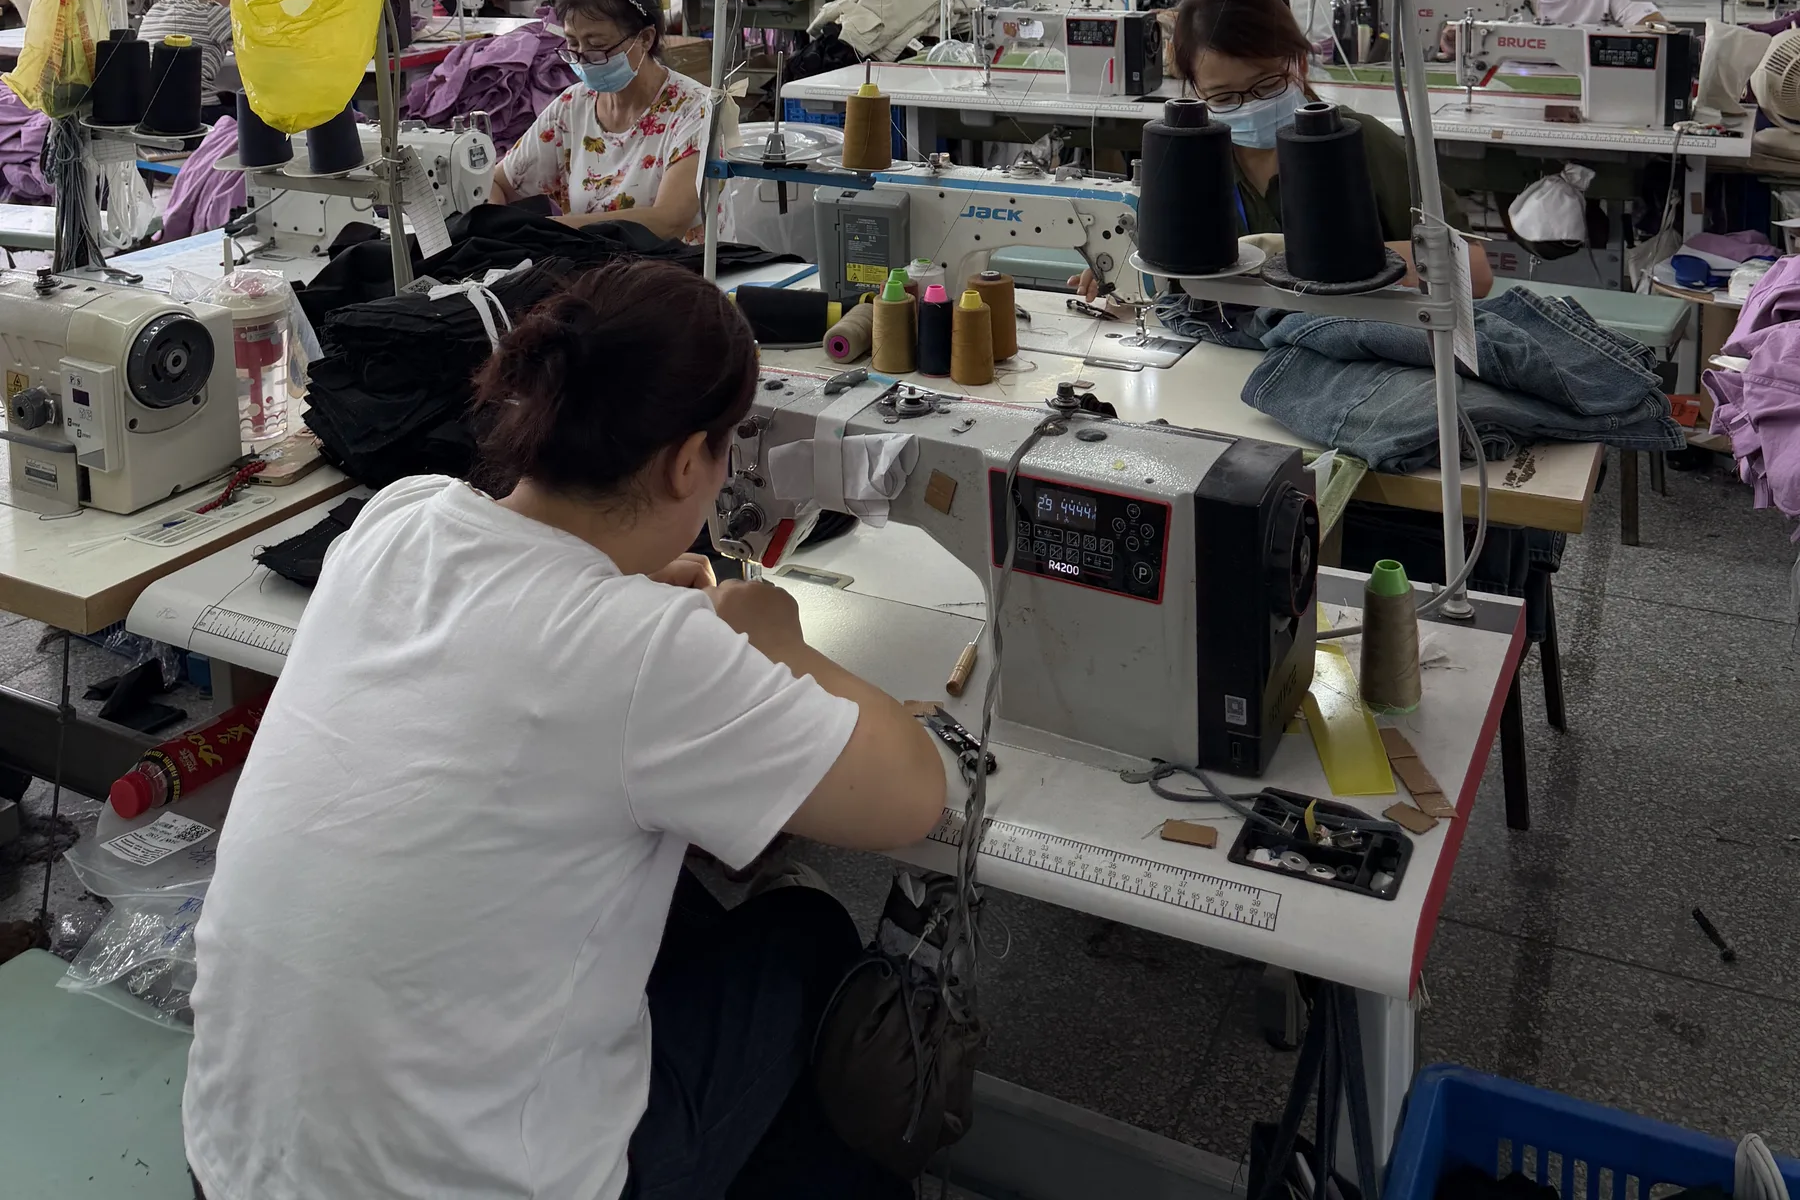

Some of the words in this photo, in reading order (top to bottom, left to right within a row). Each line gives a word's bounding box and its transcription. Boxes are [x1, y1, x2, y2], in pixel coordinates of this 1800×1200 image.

[1497, 36, 1546, 49] BRUCE
[1038, 498, 1052, 511] 29
[1049, 560, 1080, 576] R4200
[1138, 567, 1147, 579] P
